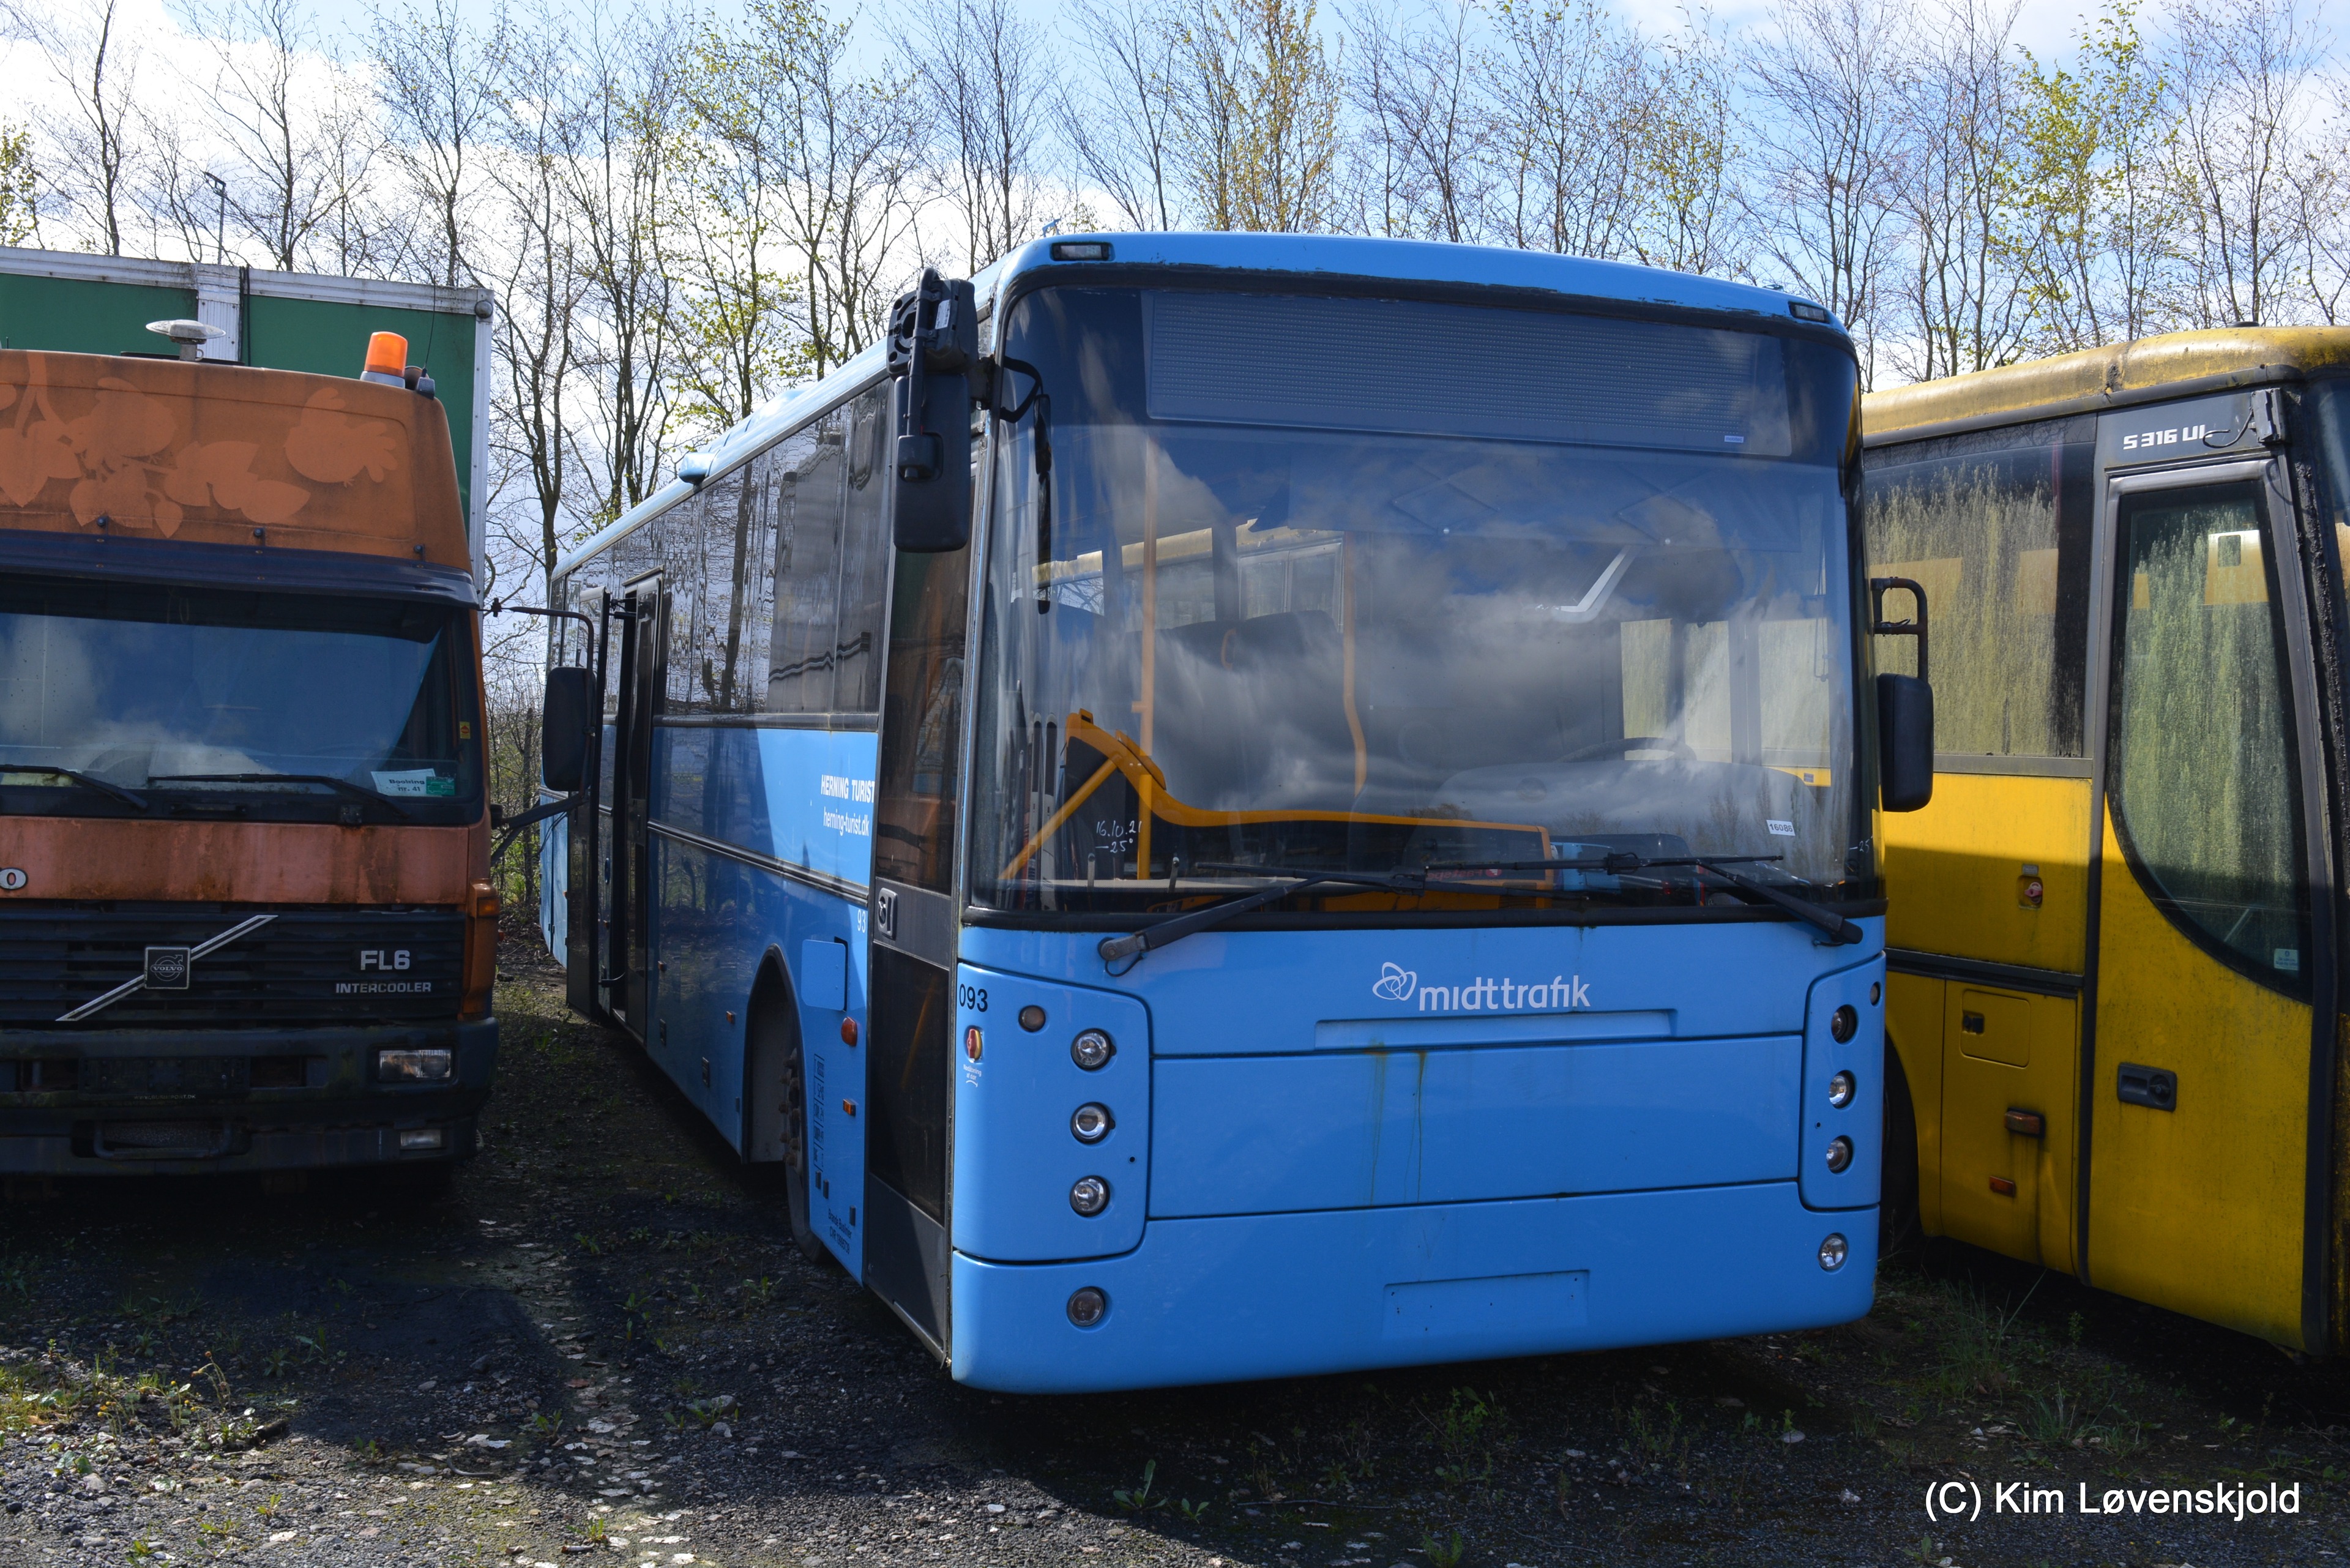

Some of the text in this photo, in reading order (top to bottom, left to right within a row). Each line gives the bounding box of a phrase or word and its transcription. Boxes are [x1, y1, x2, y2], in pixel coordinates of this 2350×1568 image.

[2122, 435, 2139, 450] S
[2141, 428, 2179, 447] 316
[821, 774, 875, 803] HERNING TURIST
[823, 806, 869, 836] herning-turist.dk
[1096, 819, 1143, 838] 16.10.21
[1769, 823, 1793, 832] 16086
[857, 909, 866, 933] 93
[360, 950, 410, 971] FL6
[335, 982, 432, 993] INTERCOOLER
[959, 983, 988, 1013] 093
[1419, 975, 1591, 1011] midttrafik
